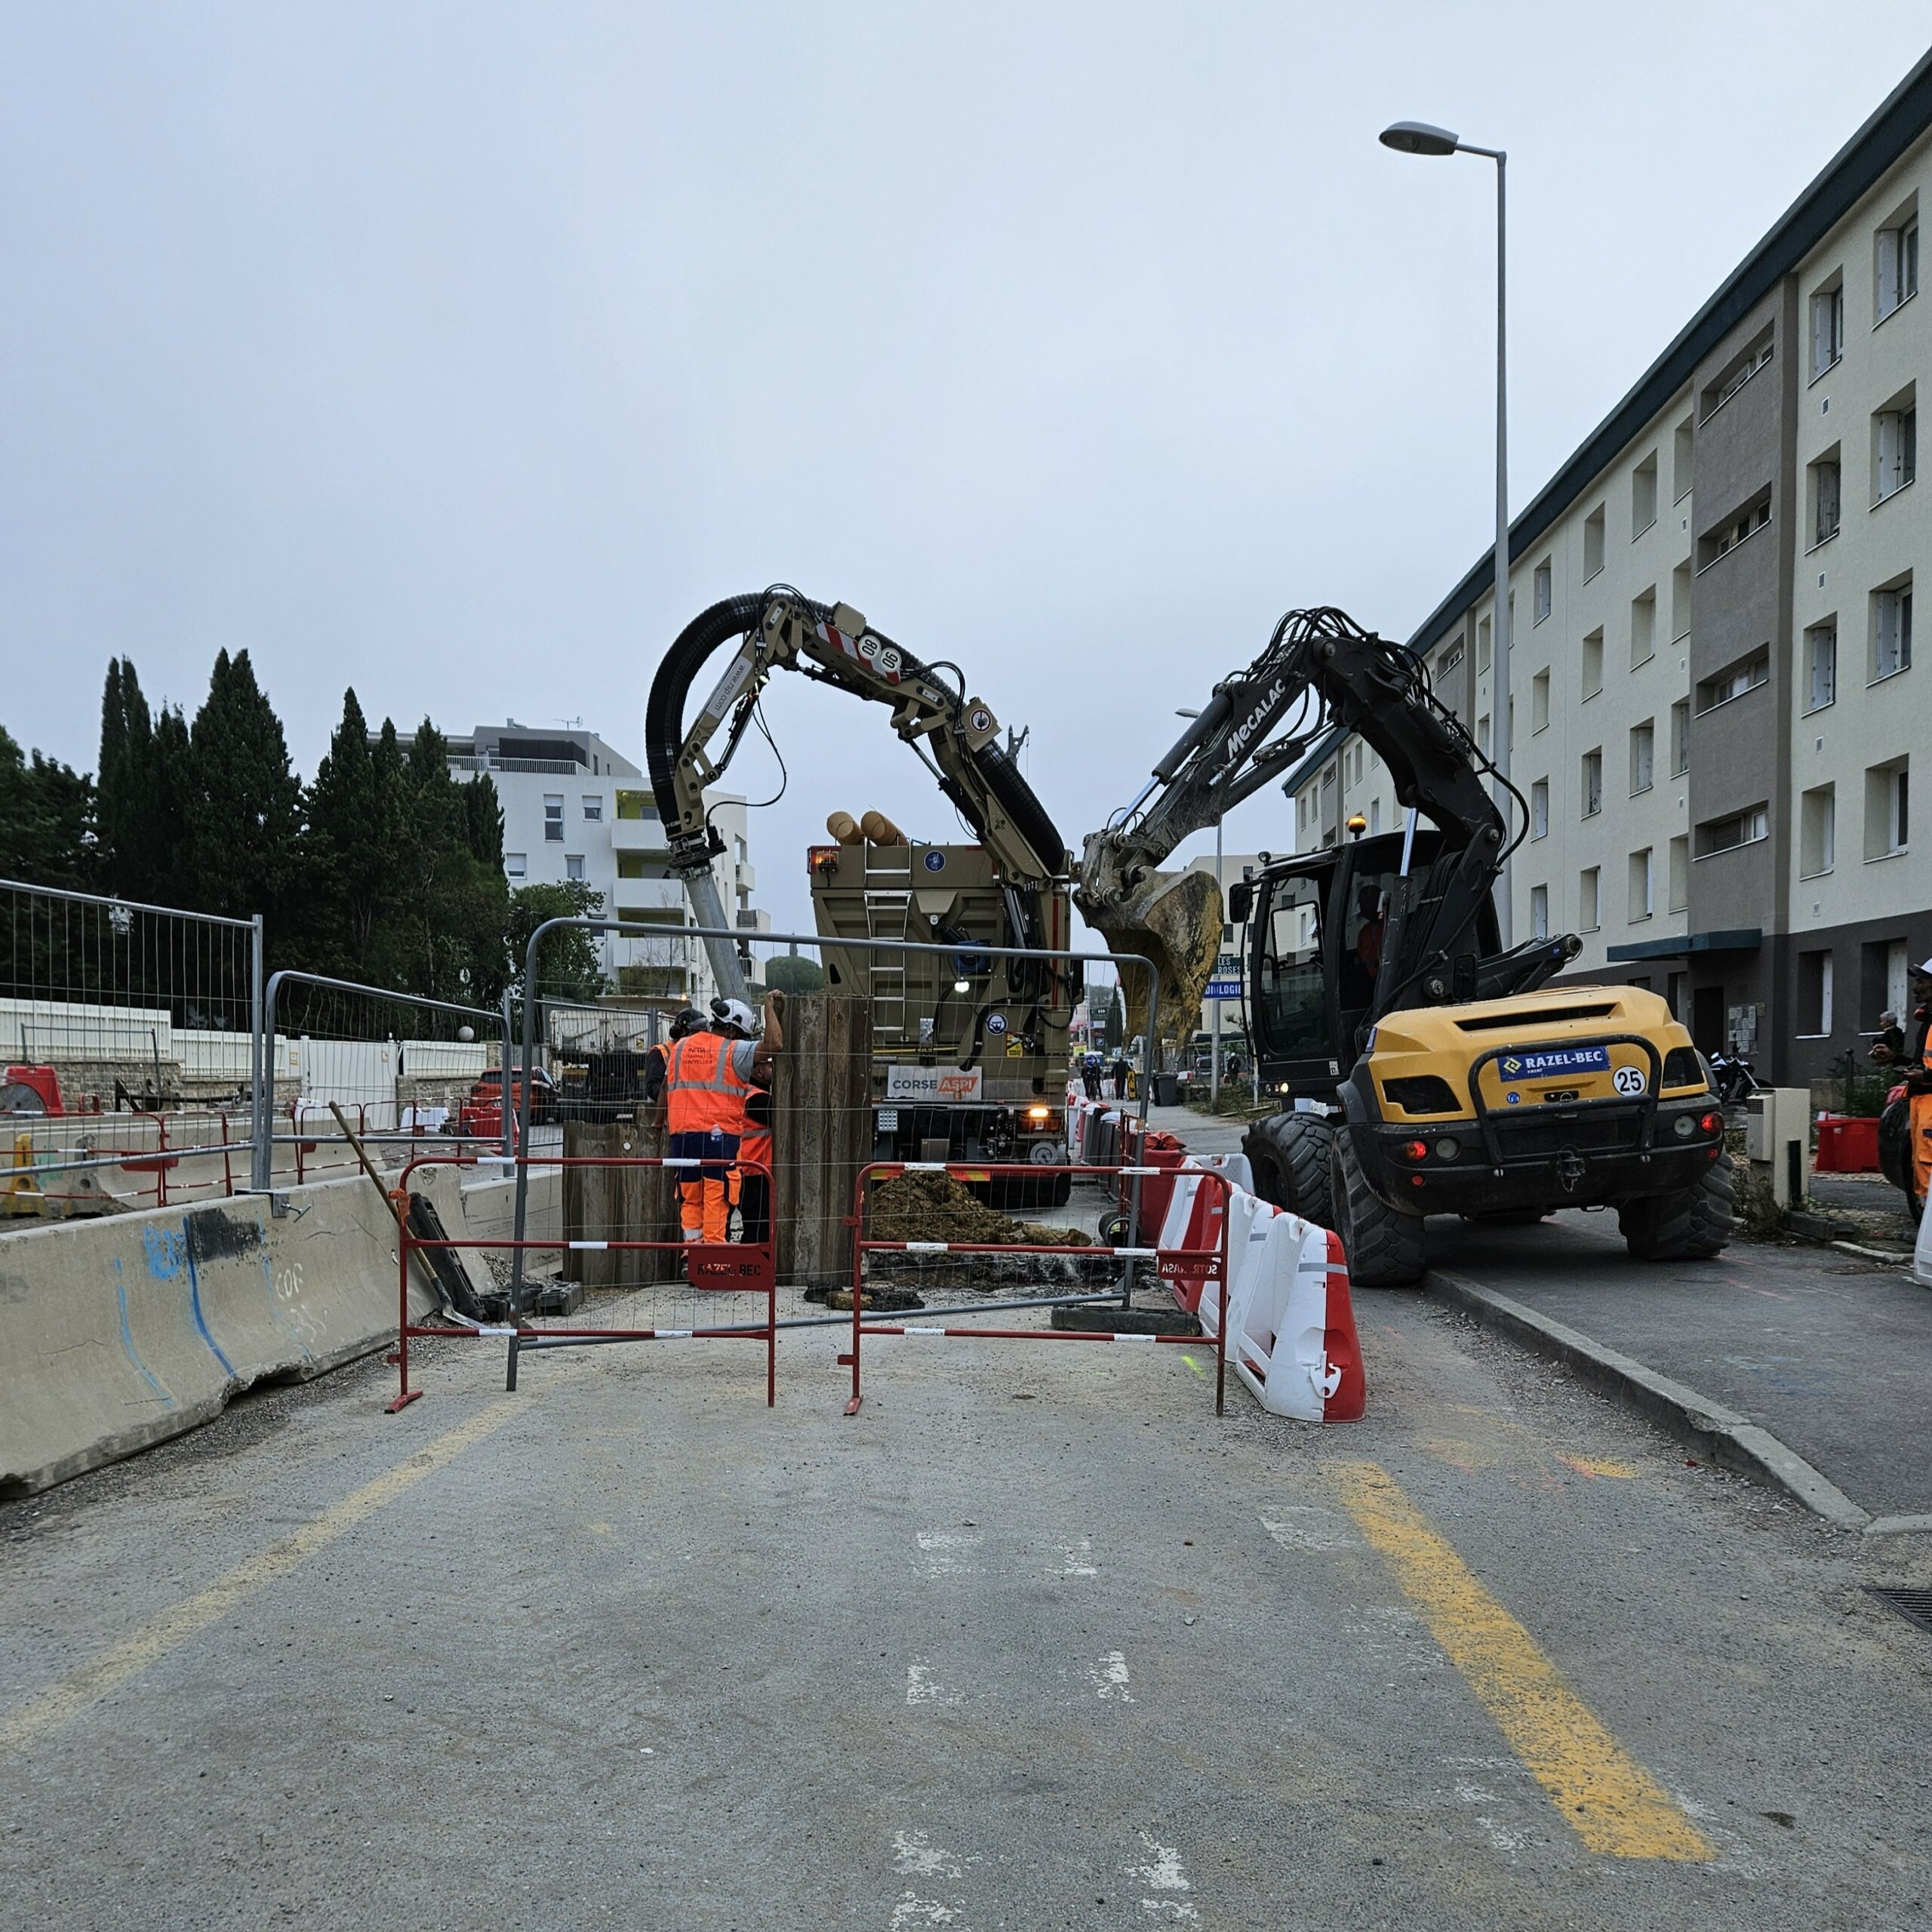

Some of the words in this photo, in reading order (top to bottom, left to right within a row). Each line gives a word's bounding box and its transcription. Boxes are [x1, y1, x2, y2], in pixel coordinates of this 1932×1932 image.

[714, 664, 746, 711] www.rsp.com
[1217, 958, 1231, 966] LES
[1524, 1051, 1603, 1069] RAZEL-BEC
[892, 1079, 938, 1089] CORSE
[1617, 1070, 1642, 1092] 25
